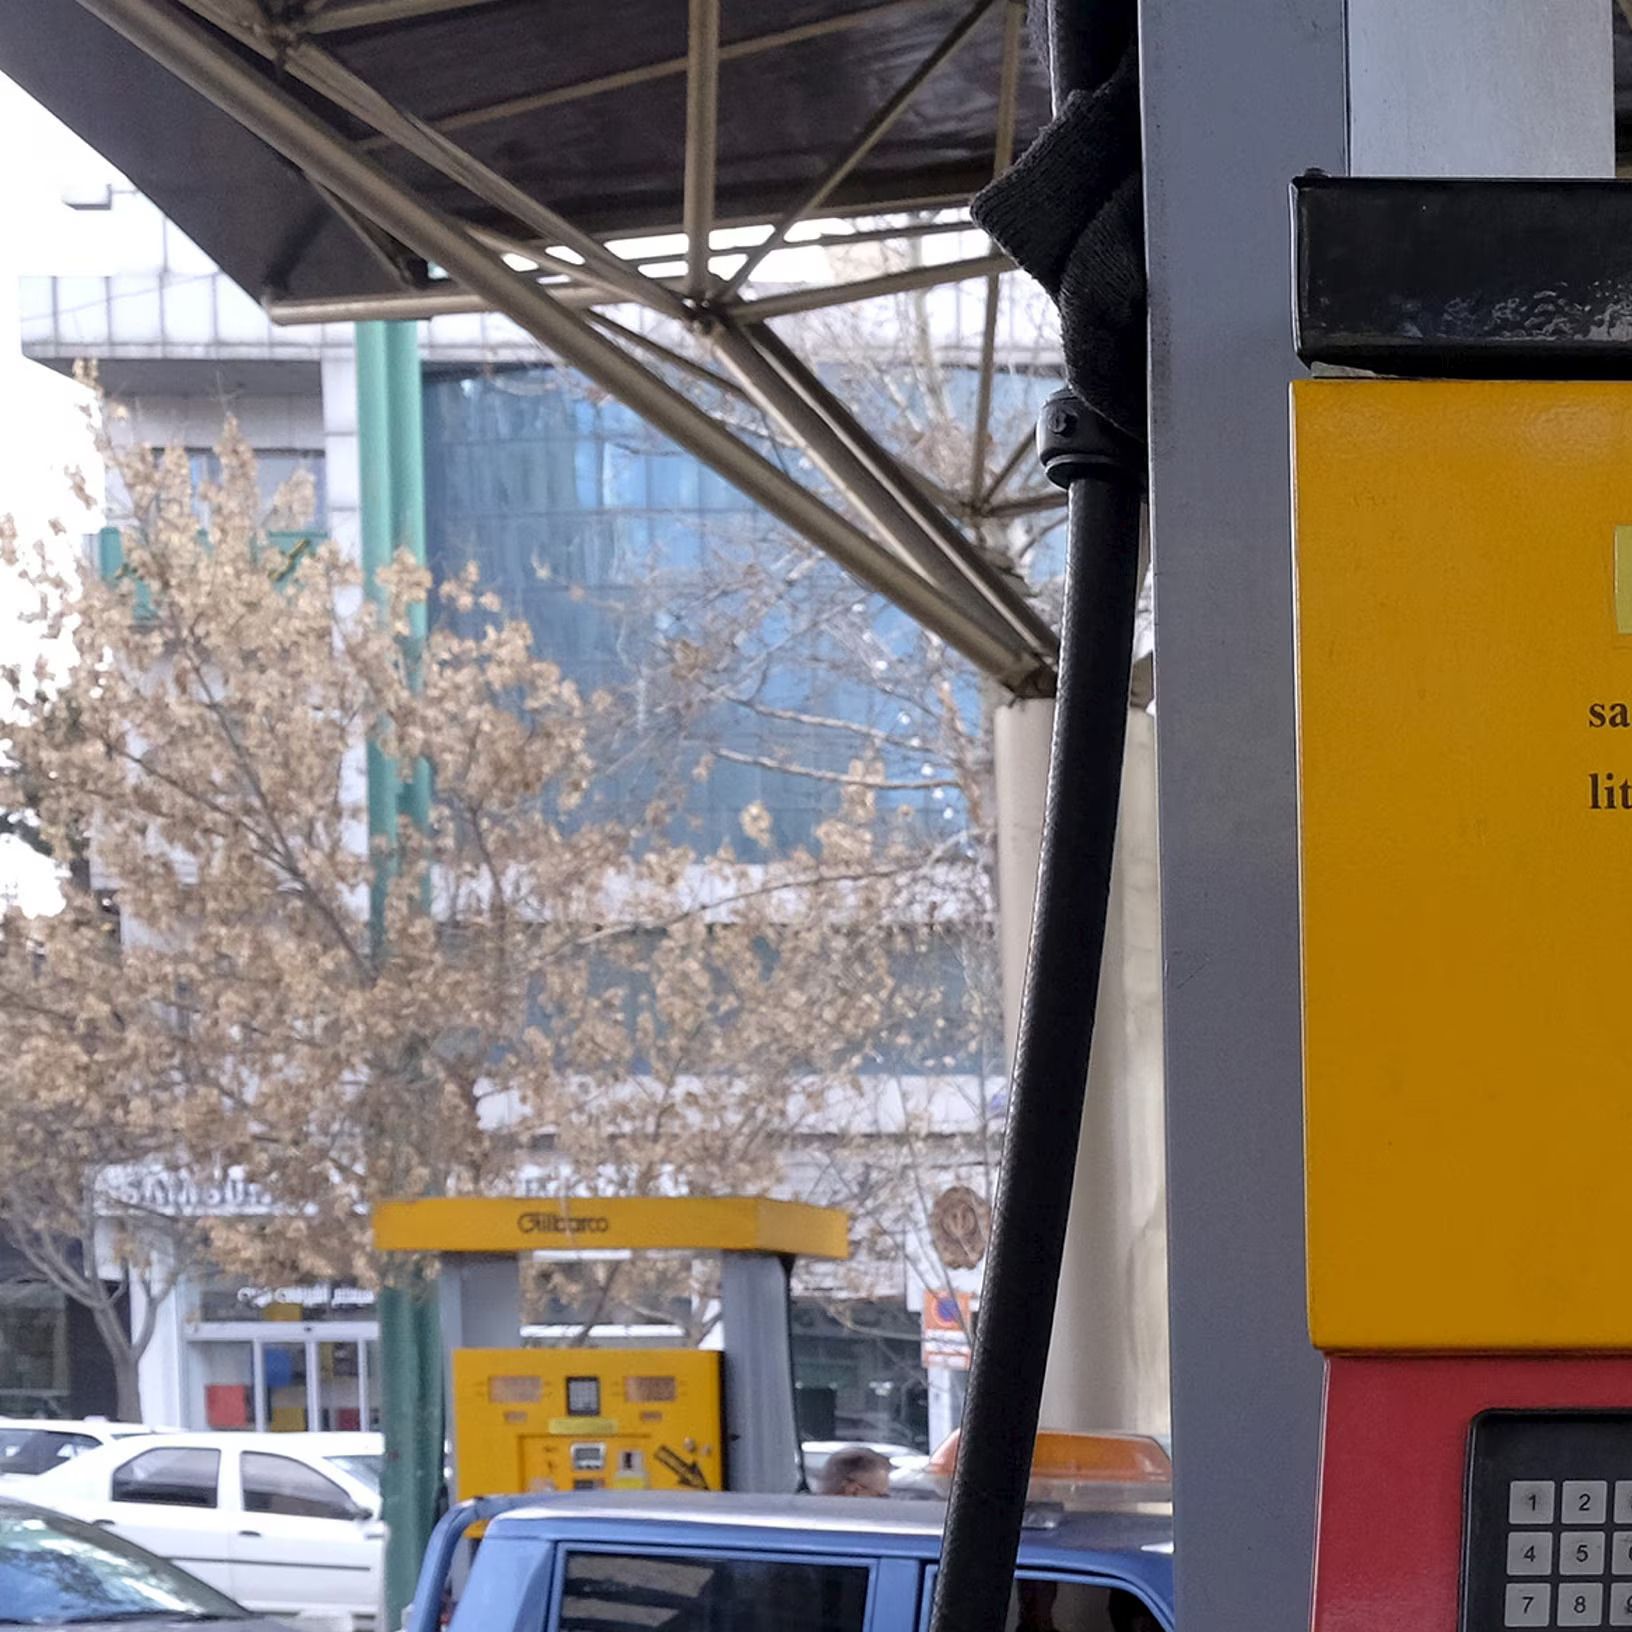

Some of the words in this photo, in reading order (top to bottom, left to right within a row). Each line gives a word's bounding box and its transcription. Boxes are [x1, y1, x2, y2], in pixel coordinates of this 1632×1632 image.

[517, 1213, 609, 1235] Gilbarco
[1527, 1494, 1537, 1511] 1
[1578, 1494, 1591, 1511] 2
[1523, 1546, 1536, 1562] 4
[1576, 1545, 1588, 1562] 5
[1522, 1596, 1534, 1613] 7
[1573, 1596, 1586, 1613] 8
